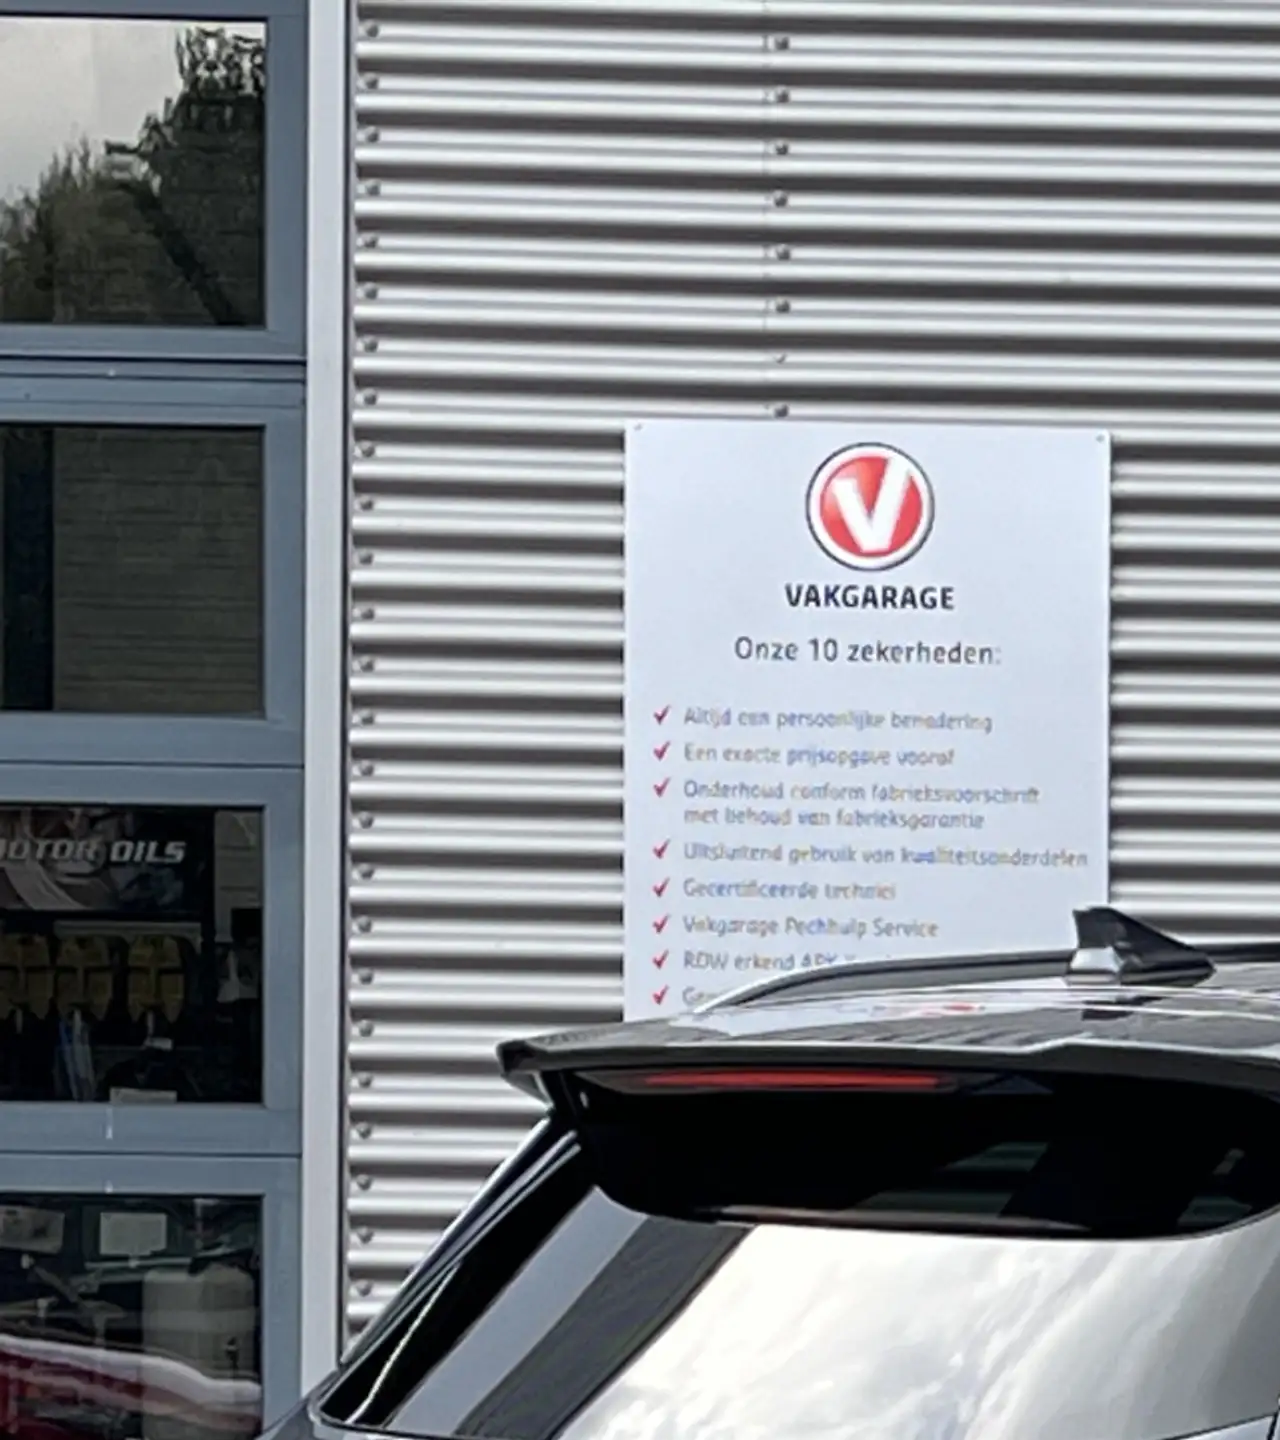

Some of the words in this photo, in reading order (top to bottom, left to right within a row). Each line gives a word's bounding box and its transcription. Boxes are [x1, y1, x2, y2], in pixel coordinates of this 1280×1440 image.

[785, 584, 955, 610] VAKGARAGE
[735, 636, 798, 661] Onze
[810, 638, 838, 662] 10
[847, 639, 1001, 666] zekerheden:
[684, 708, 731, 730] Altijd
[737, 712, 770, 728] een
[776, 710, 885, 733] persoonlijke
[891, 711, 992, 735] benadering
[684, 745, 717, 762] Een
[722, 747, 780, 764] exacte
[787, 747, 890, 768] prijsopgave
[896, 748, 955, 767] vooraf
[684, 780, 784, 800] Onderhoud
[790, 783, 867, 801] conform
[872, 784, 1040, 804] fabrieksvoorschrift
[684, 807, 718, 824] met
[725, 807, 791, 826] behoud
[798, 811, 830, 827] van
[836, 809, 985, 832] fabrieksgarantie
[110, 840, 187, 863] OILS
[788, 845, 856, 867] gebruik
[862, 848, 895, 864] van
[683, 878, 819, 899] Gecertificeerde
[785, 916, 867, 938] Pechhulp
[873, 918, 939, 938] Service
[683, 952, 728, 970] RDW
[733, 953, 795, 972] erkend
